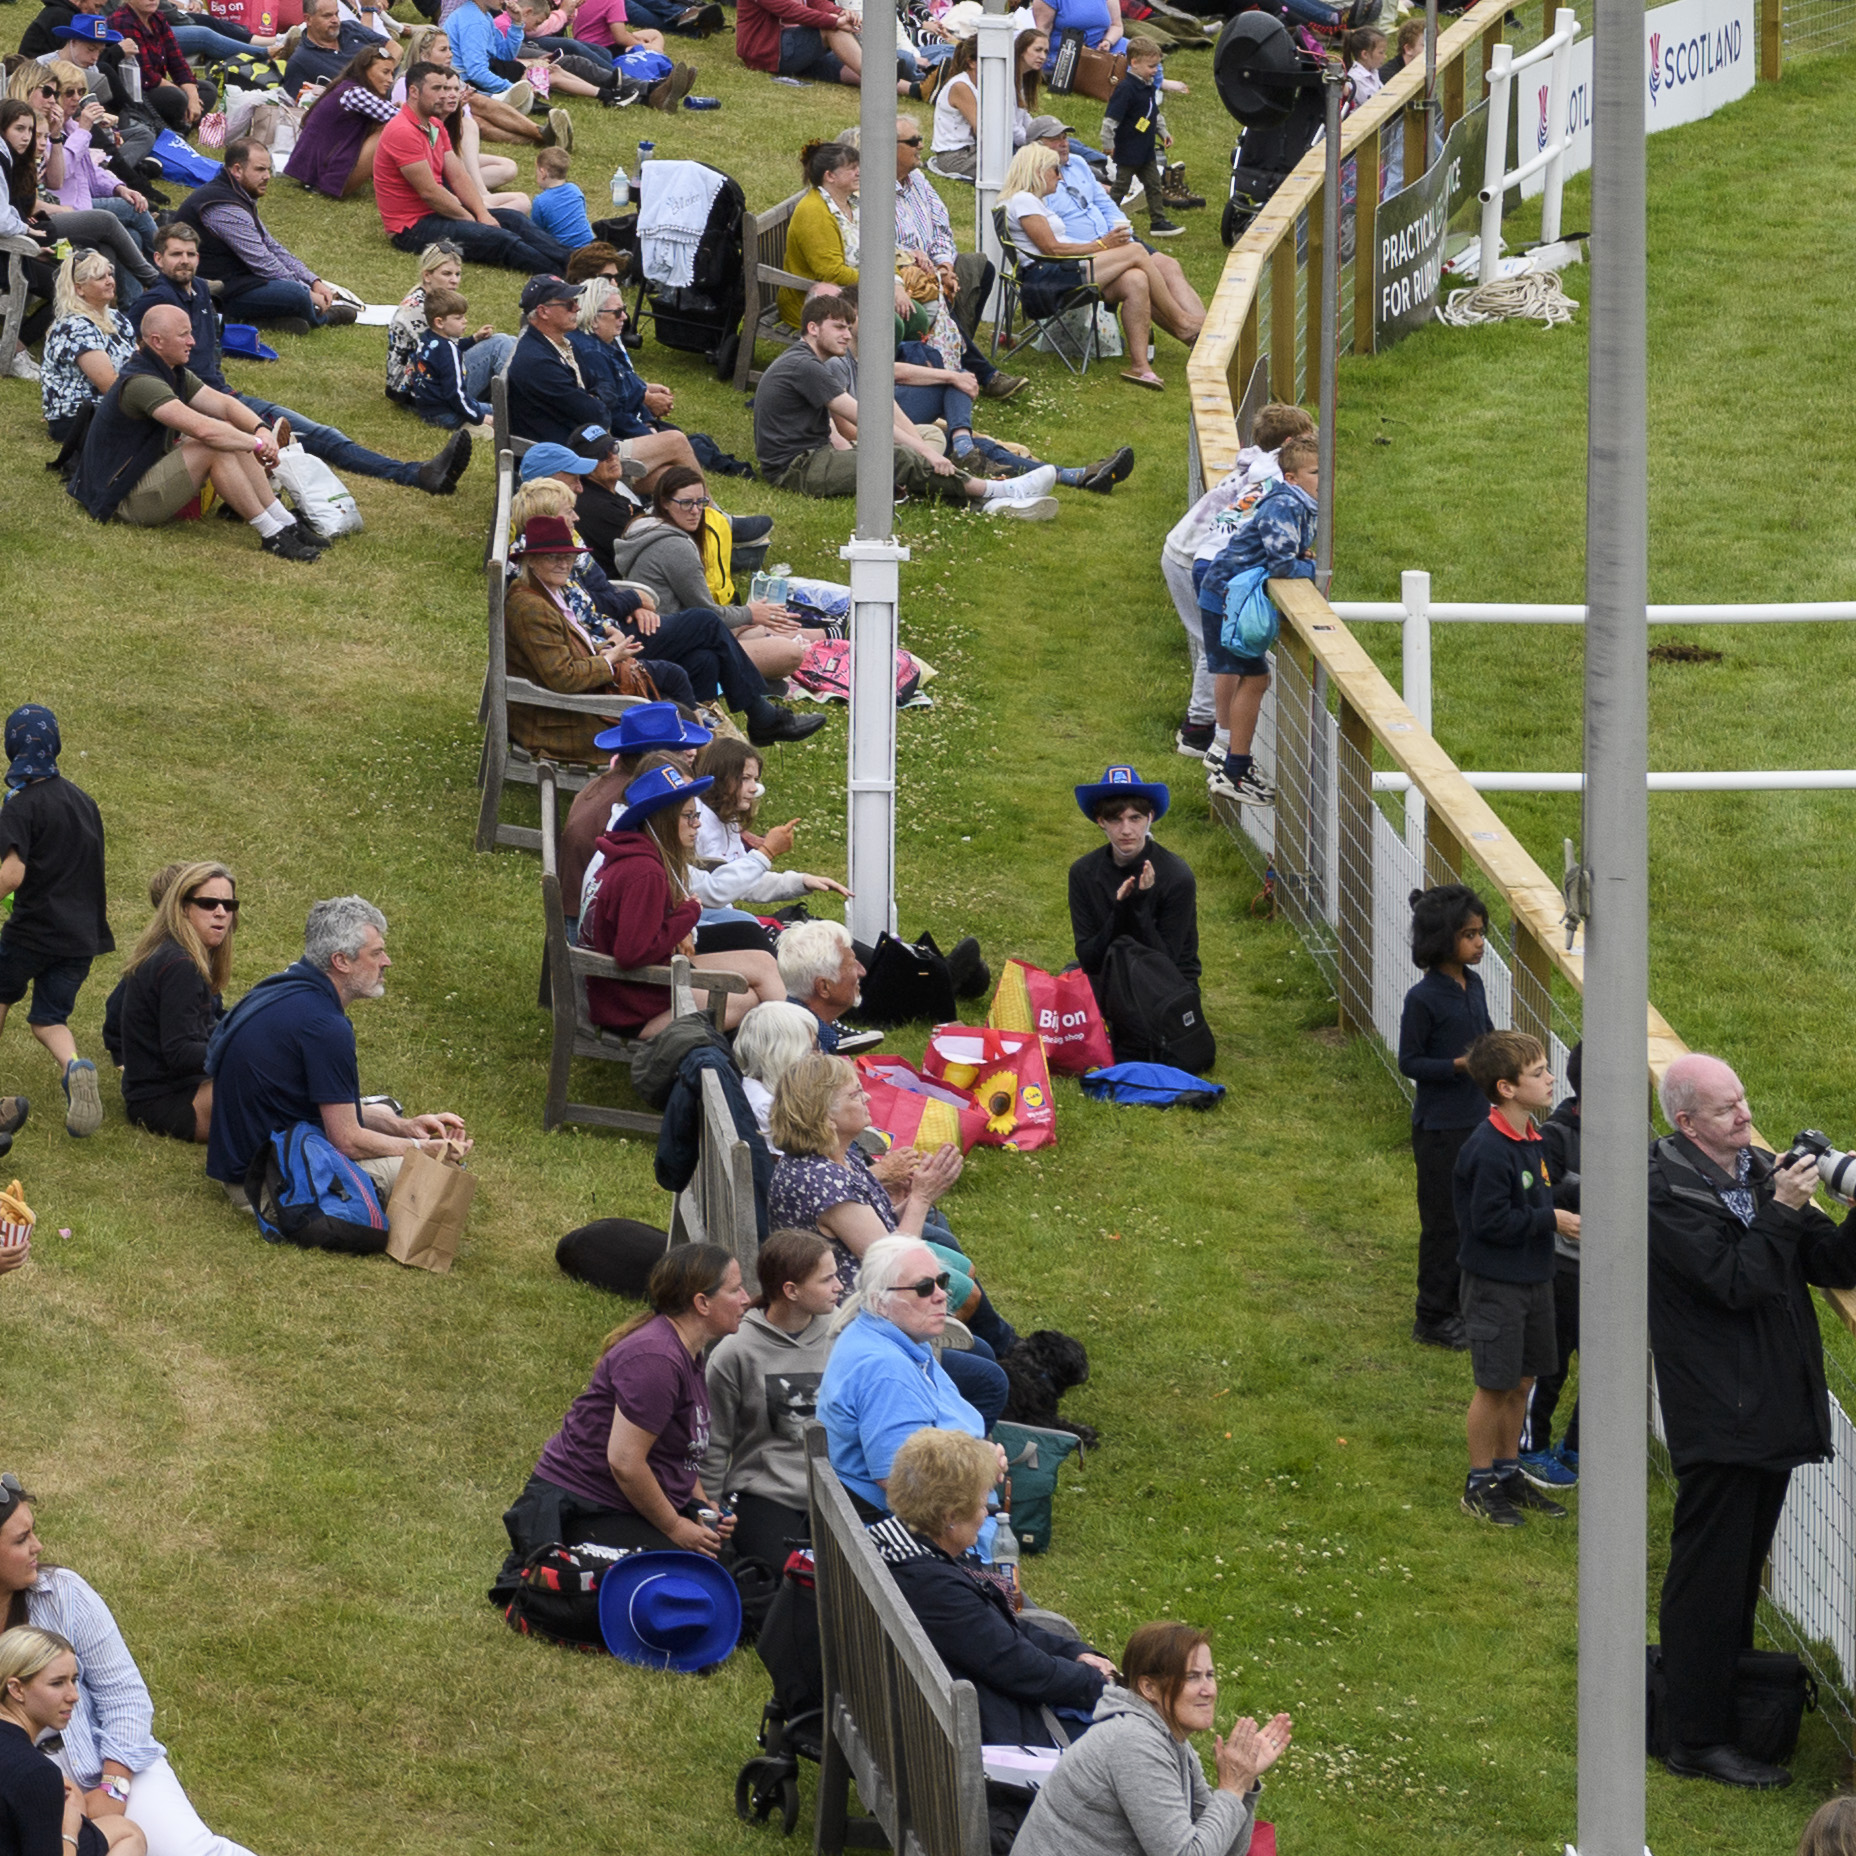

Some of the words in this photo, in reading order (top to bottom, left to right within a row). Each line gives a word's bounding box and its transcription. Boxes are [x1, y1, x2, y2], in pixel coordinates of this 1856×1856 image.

[210, 1, 226, 14] Big
[228, 2, 244, 11] on
[1664, 19, 1742, 89] SCOTLAND
[1382, 276, 1412, 322] FOR
[1061, 1010, 1086, 1026] on
[1064, 1032, 1084, 1043] shop
